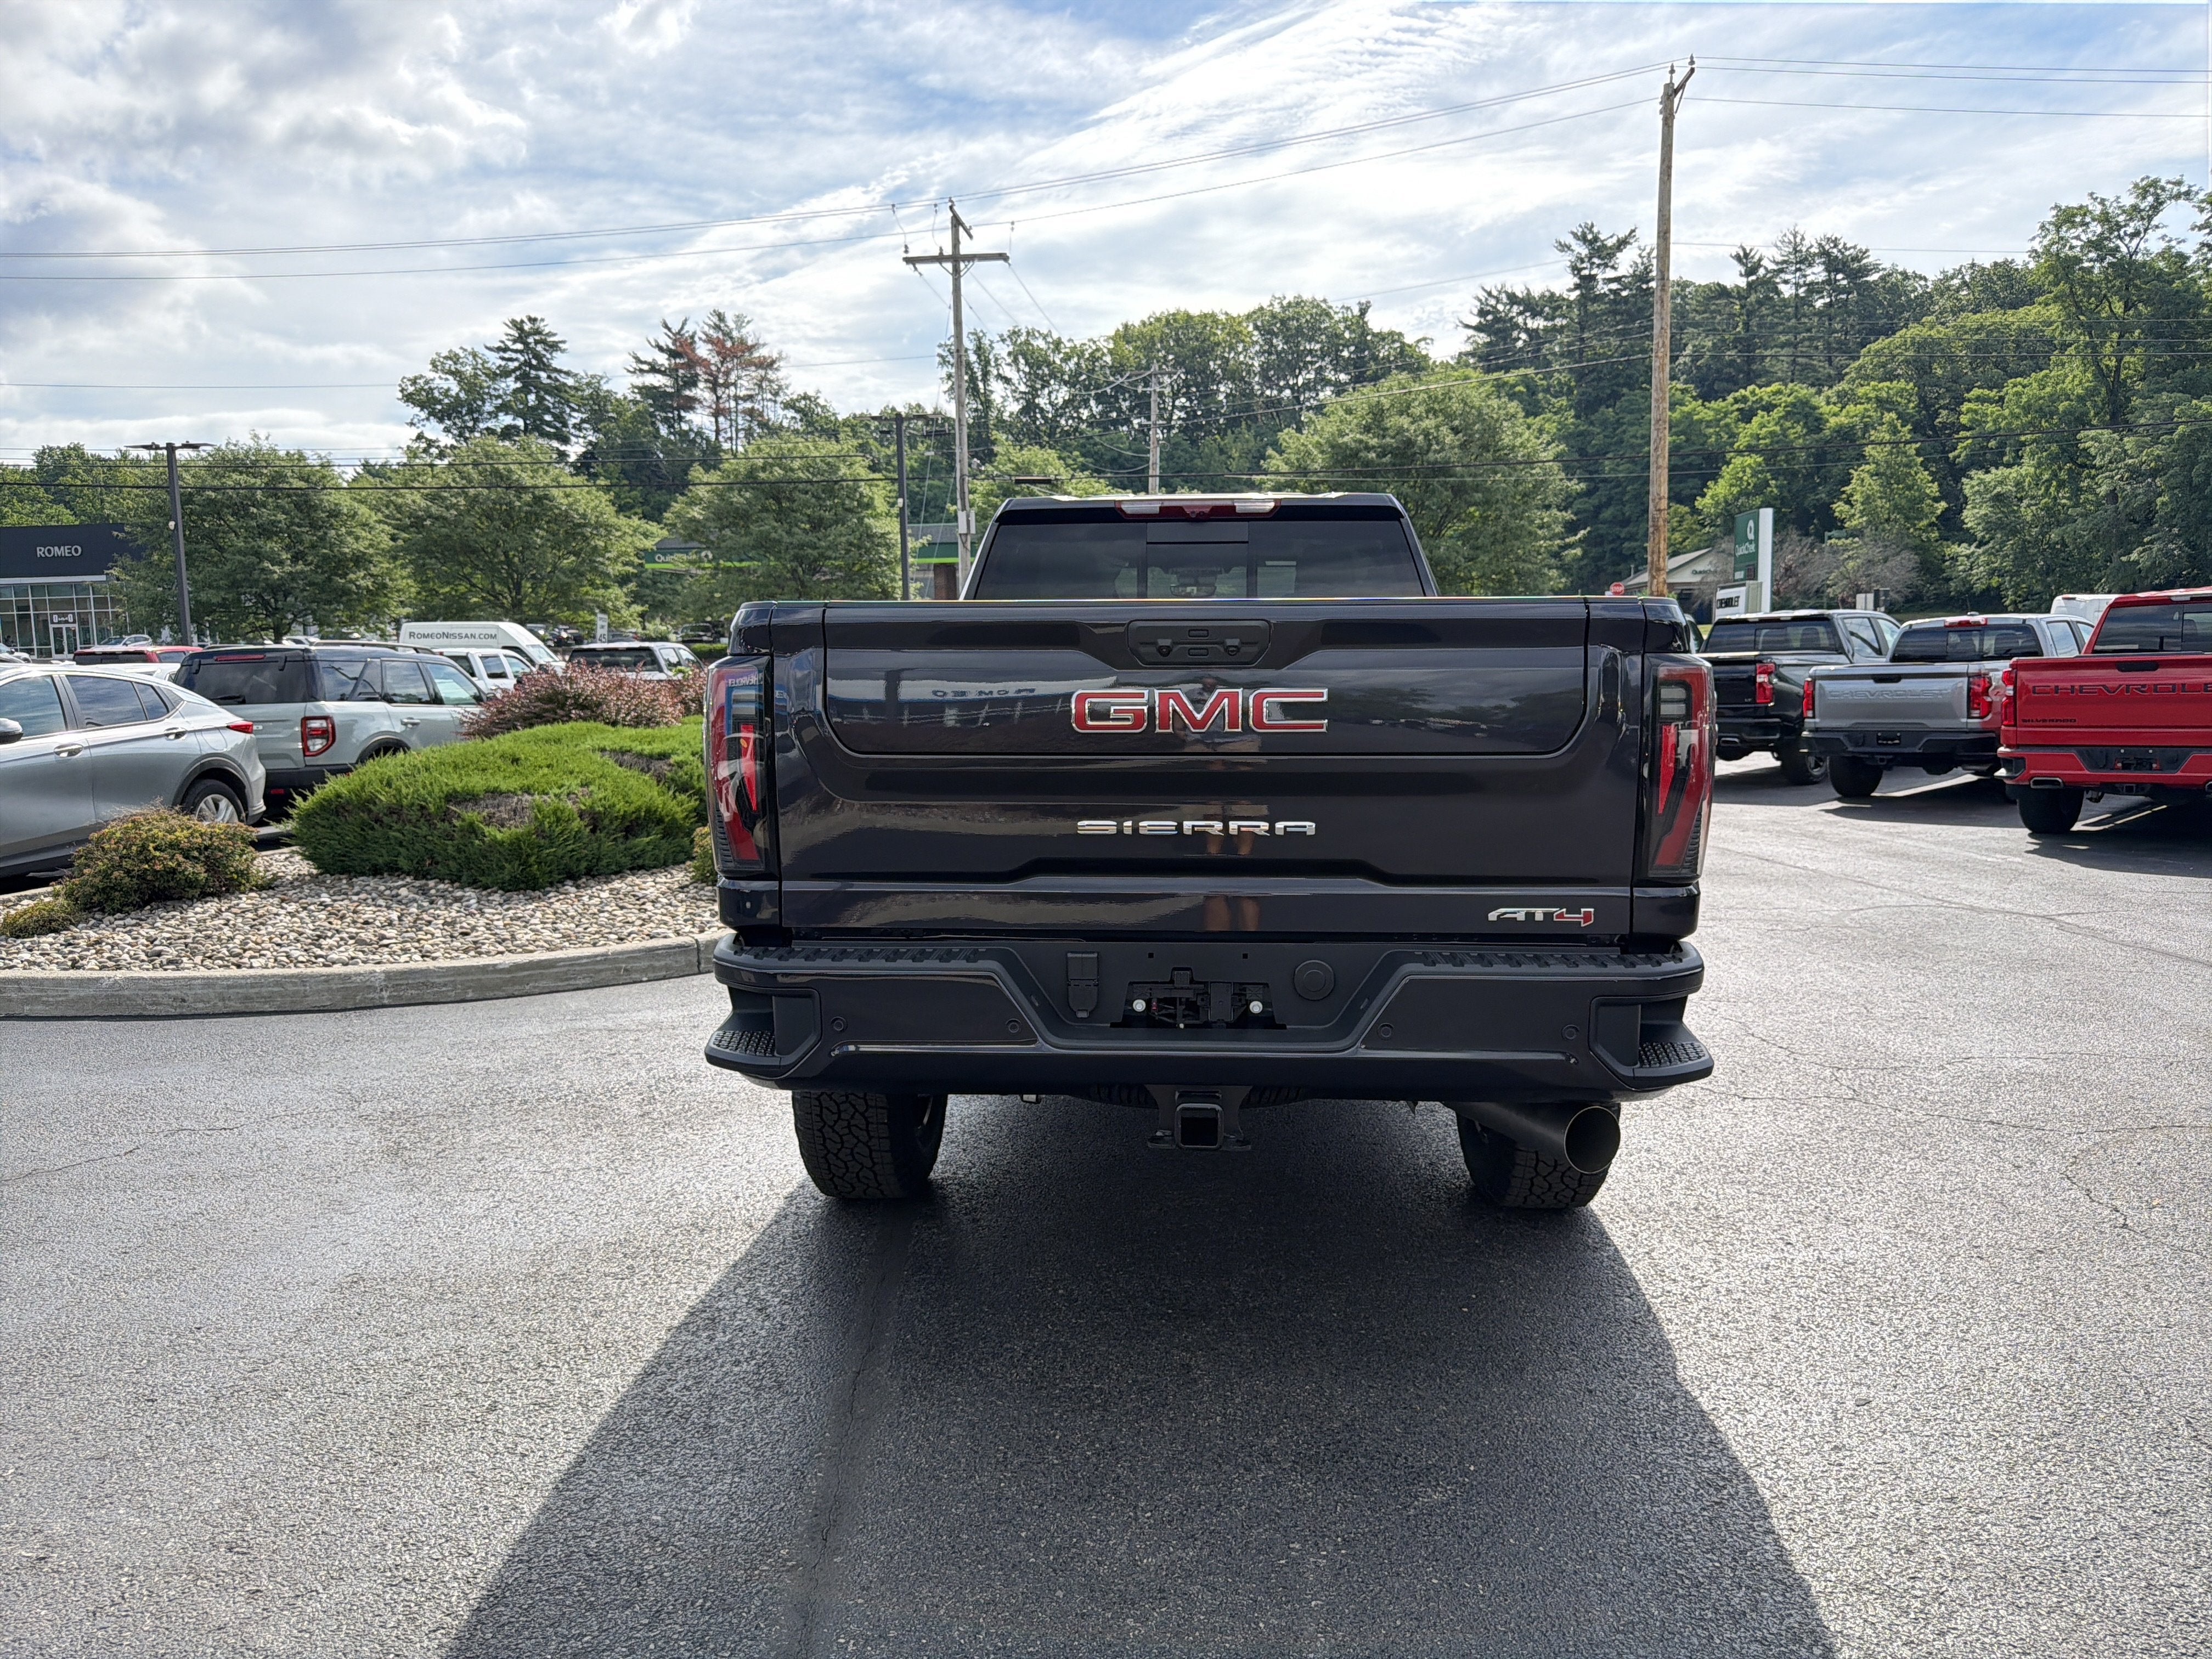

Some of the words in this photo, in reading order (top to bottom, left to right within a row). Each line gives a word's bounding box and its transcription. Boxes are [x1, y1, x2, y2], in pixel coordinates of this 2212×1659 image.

[36, 545, 82, 558] ROMEO
[1735, 540, 1756, 558] QuickChek
[598, 634, 607, 643] 45
[1827, 689, 1951, 699] CHEVROLET
[1071, 688, 1328, 733] GMC
[1077, 821, 1316, 836] SIERRA
[1488, 908, 1595, 927] AT4
